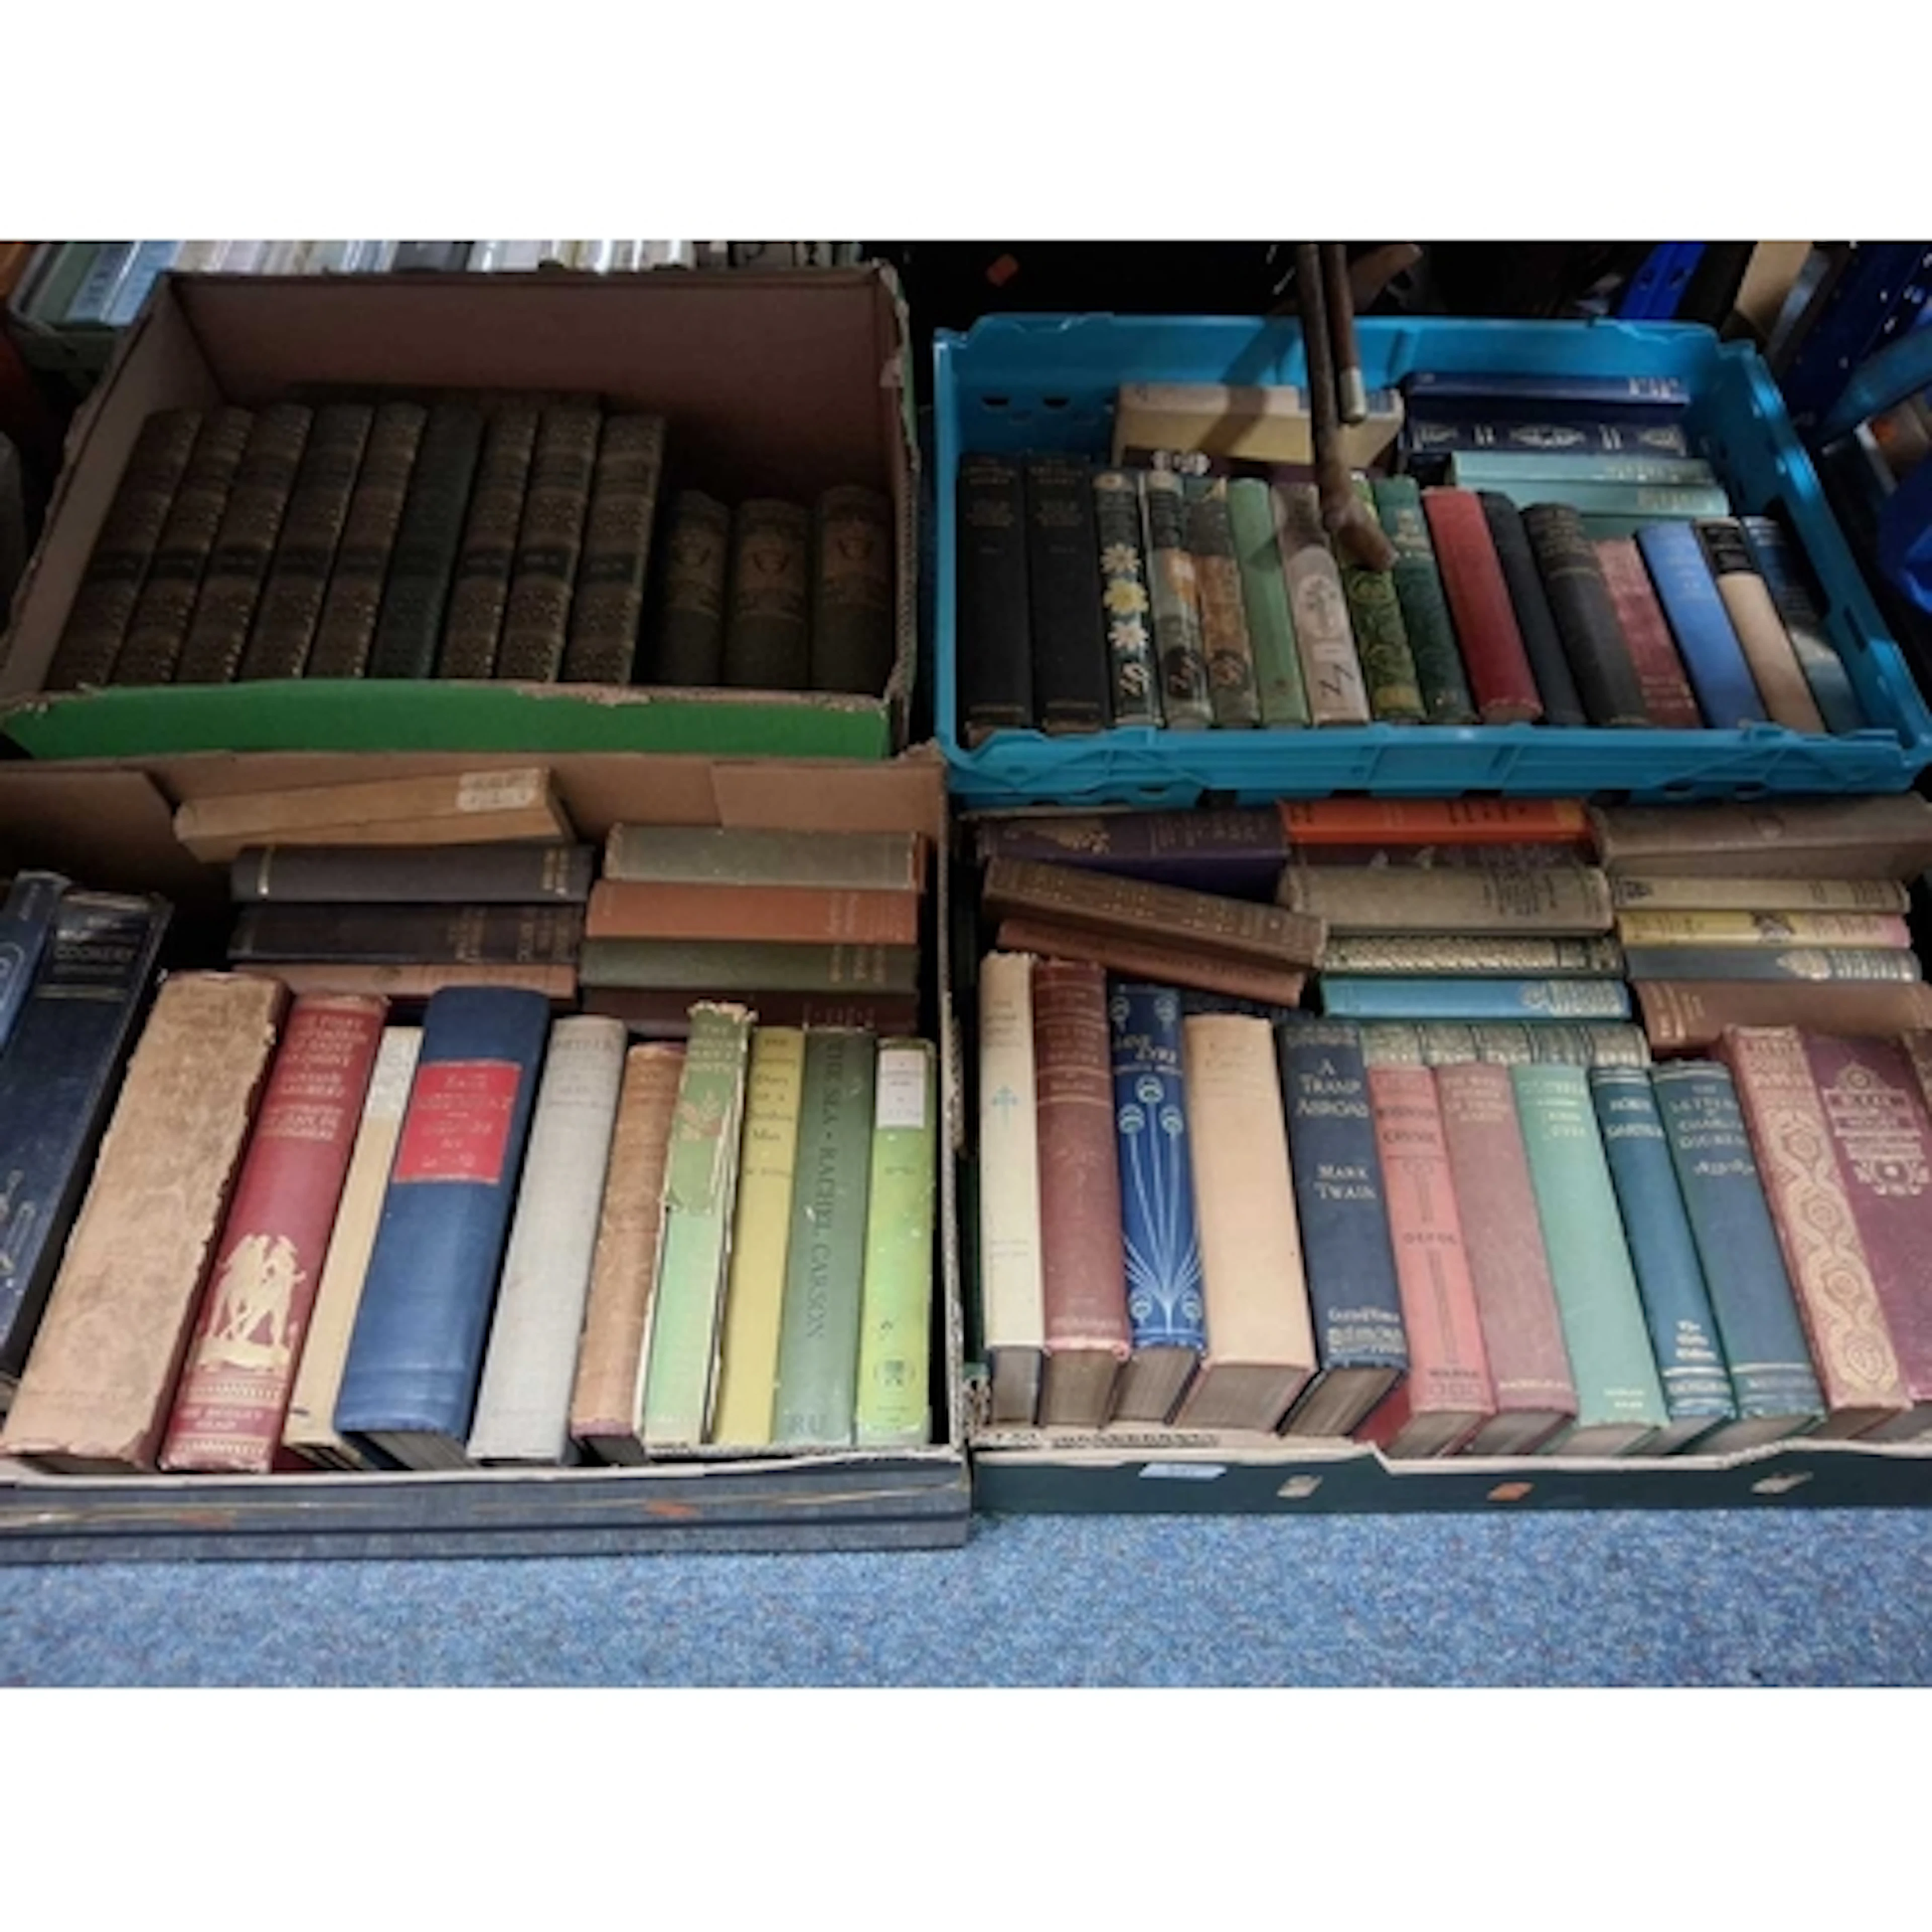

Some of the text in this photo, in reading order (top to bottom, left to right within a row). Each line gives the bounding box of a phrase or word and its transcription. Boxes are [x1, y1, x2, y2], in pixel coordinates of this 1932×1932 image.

[1319, 1059, 1336, 1076] A
[1299, 1073, 1361, 1094] TRAMP
[823, 1088, 842, 1124] SEA
[1296, 1098, 1369, 1118] ABROAD
[1318, 1164, 1369, 1180] MARK
[815, 1147, 838, 1236] RACHEL
[1314, 1182, 1377, 1199] TWAIN
[807, 1243, 831, 1339] CARSON
